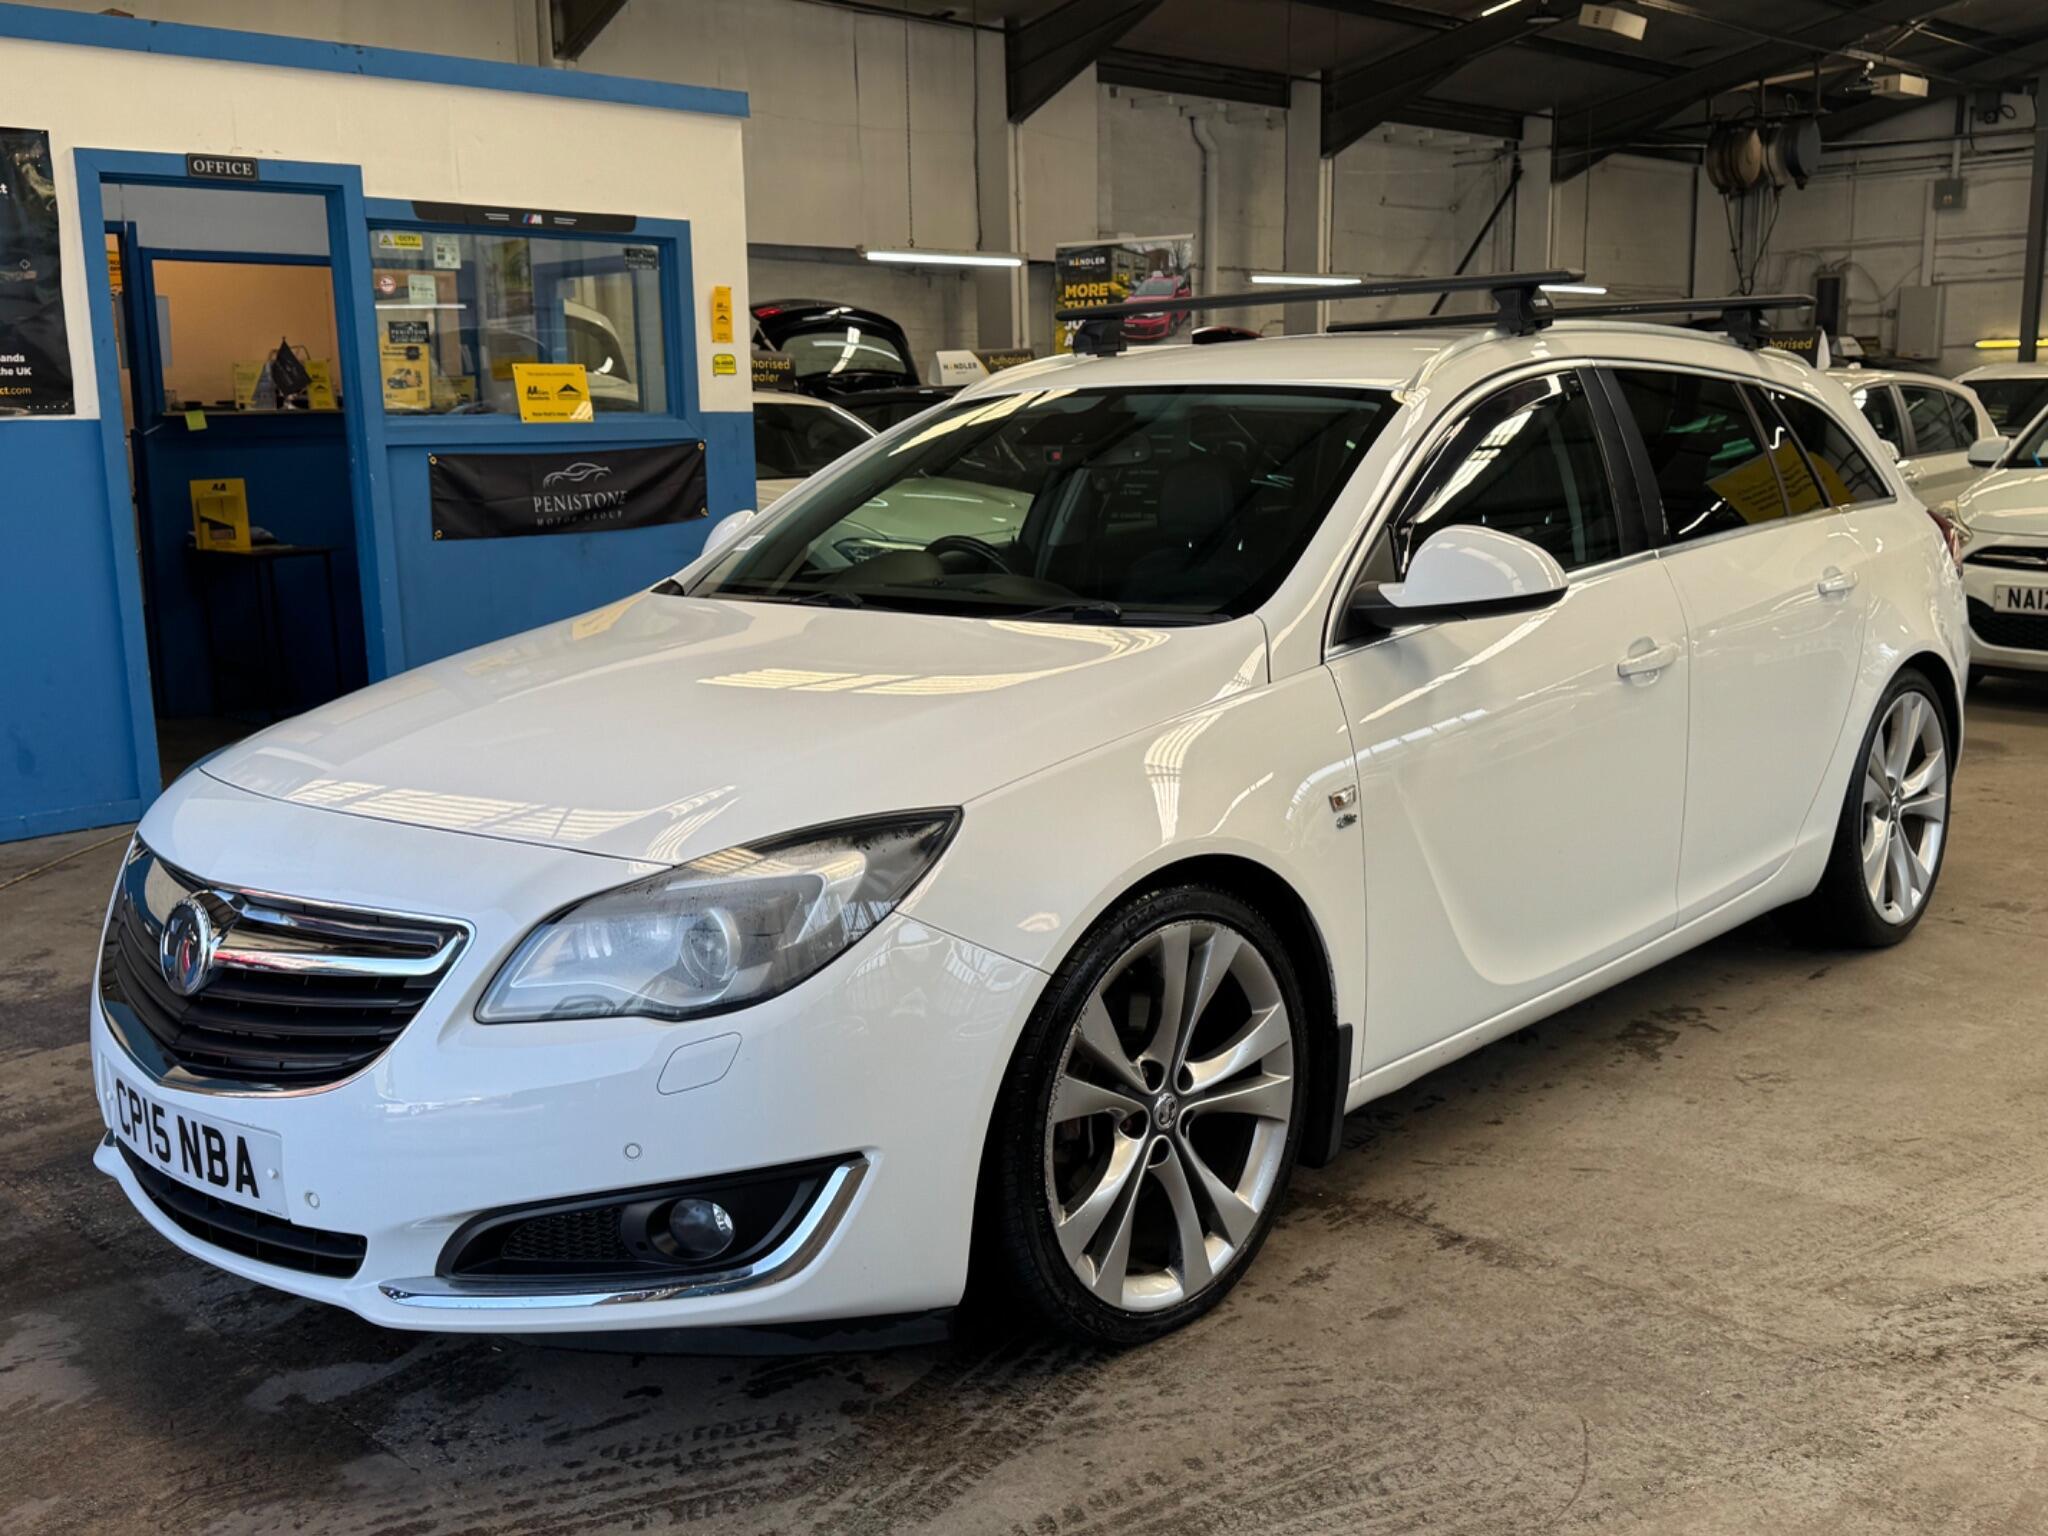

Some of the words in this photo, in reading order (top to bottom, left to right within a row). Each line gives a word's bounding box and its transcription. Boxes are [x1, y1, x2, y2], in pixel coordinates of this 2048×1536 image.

[193, 160, 253, 175] OFFICE
[1065, 283, 1109, 298] MORE
[16, 367, 32, 376] UK
[533, 490, 627, 513] PENISTONE
[116, 1077, 172, 1164] CP15
[177, 1114, 261, 1200] NBA
